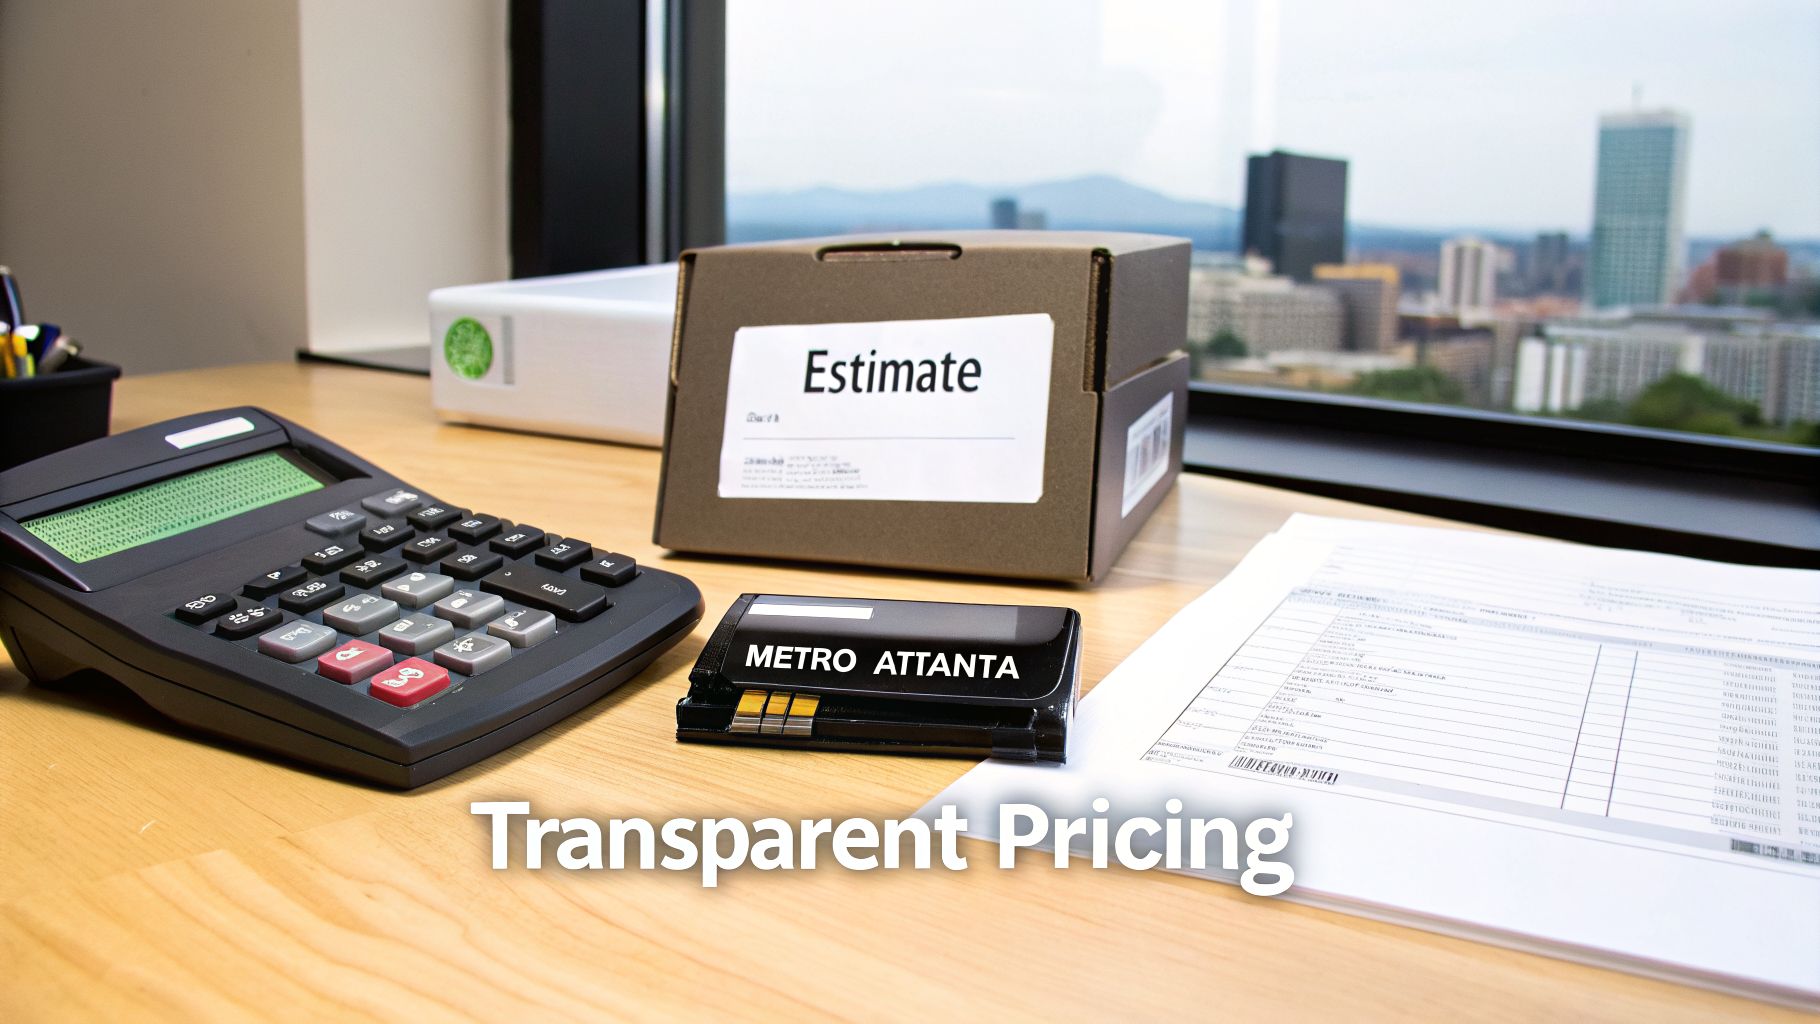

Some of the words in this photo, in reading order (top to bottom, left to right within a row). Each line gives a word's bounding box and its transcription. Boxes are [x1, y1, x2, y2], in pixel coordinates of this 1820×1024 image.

[803, 349, 982, 394] Estimate
[745, 644, 857, 673] METRO
[872, 650, 1020, 680] ATTANTA
